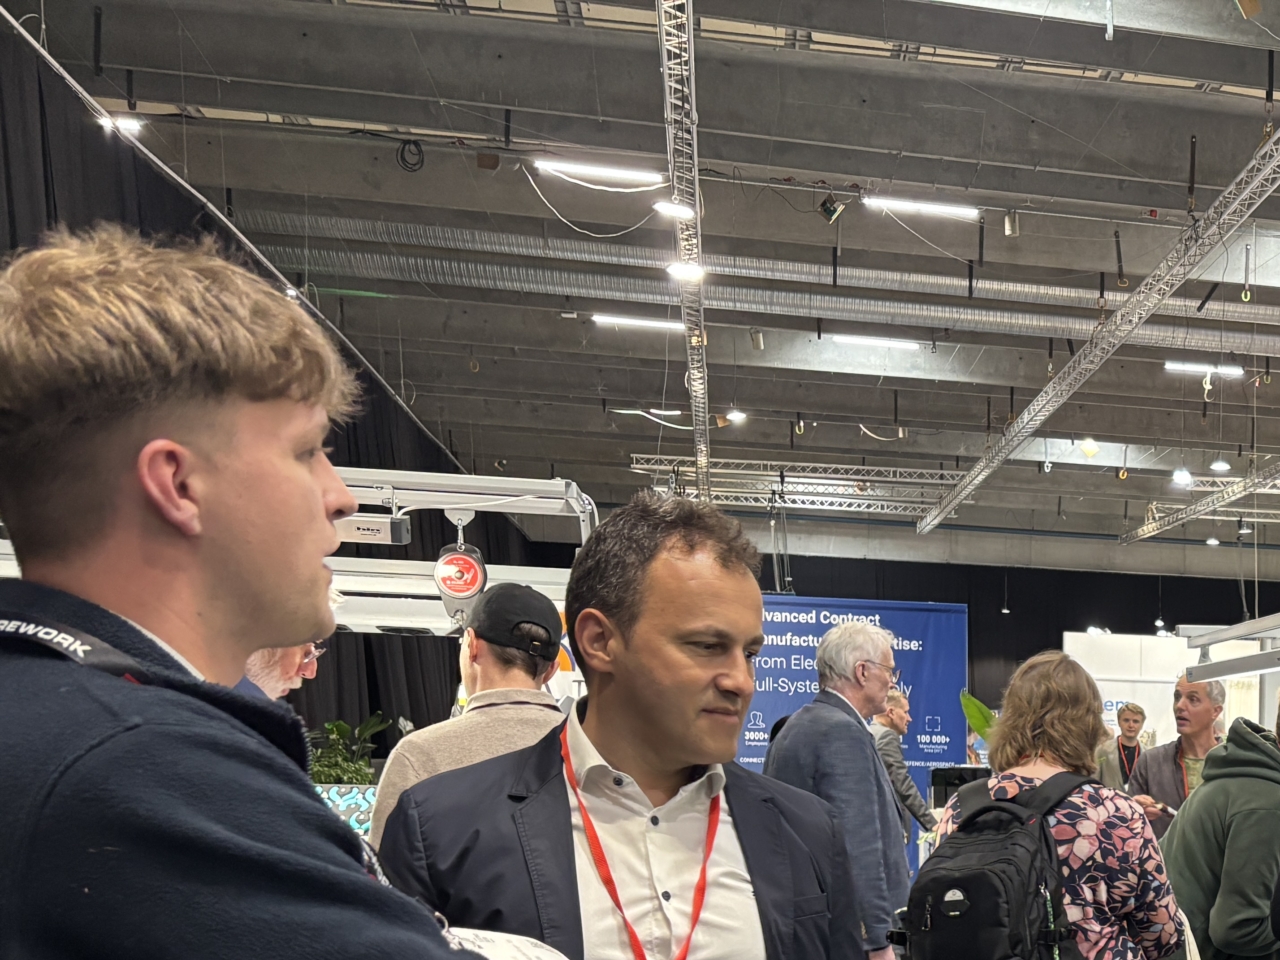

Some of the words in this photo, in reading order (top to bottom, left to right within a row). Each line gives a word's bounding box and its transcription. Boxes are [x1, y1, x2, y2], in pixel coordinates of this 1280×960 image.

[762, 609, 816, 624] vanced
[820, 611, 881, 626] Contract
[763, 631, 820, 647] anufactu
[892, 637, 923, 651] tise:
[754, 677, 820, 696] ull-Syste
[744, 731, 769, 740] 3000+
[916, 734, 931, 743] 100
[931, 734, 951, 744] 000+
